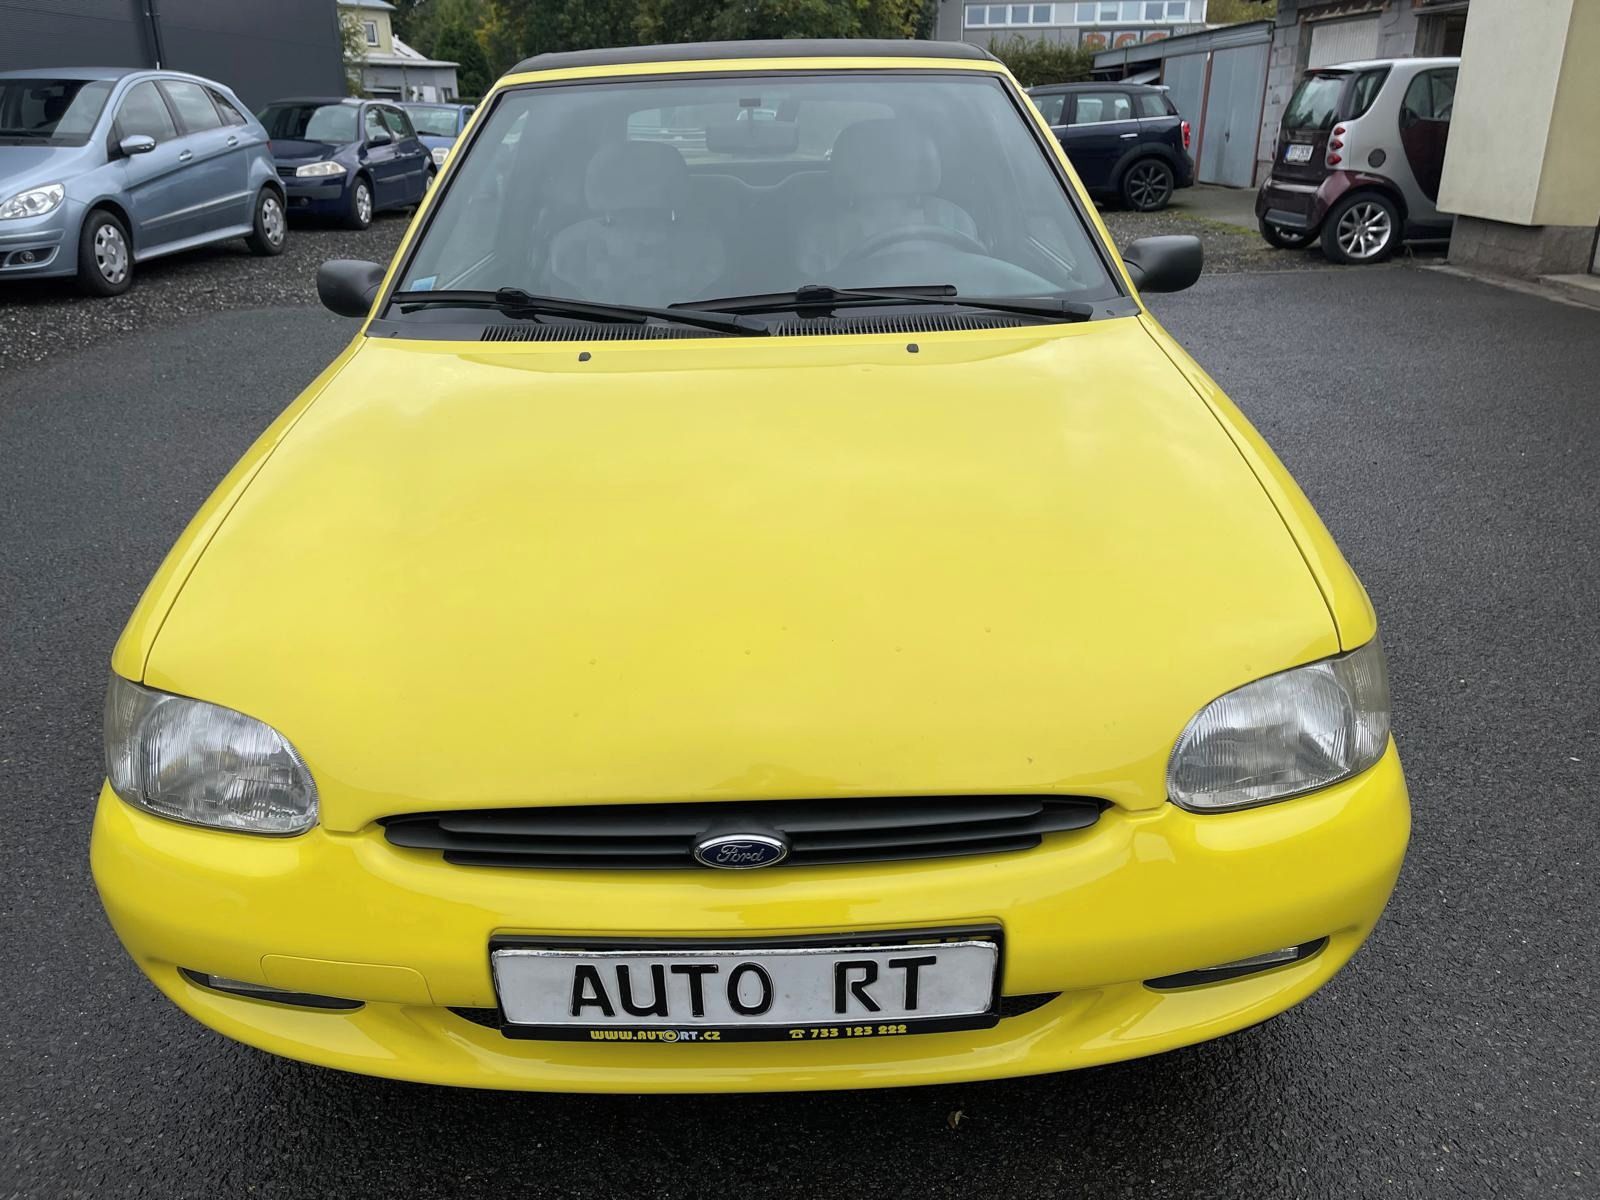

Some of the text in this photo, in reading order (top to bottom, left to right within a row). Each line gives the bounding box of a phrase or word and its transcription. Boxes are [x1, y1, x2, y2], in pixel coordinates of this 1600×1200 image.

[716, 844, 765, 863] Ford
[569, 955, 937, 1017] AUTO RT
[810, 1024, 907, 1038] 733 123 222
